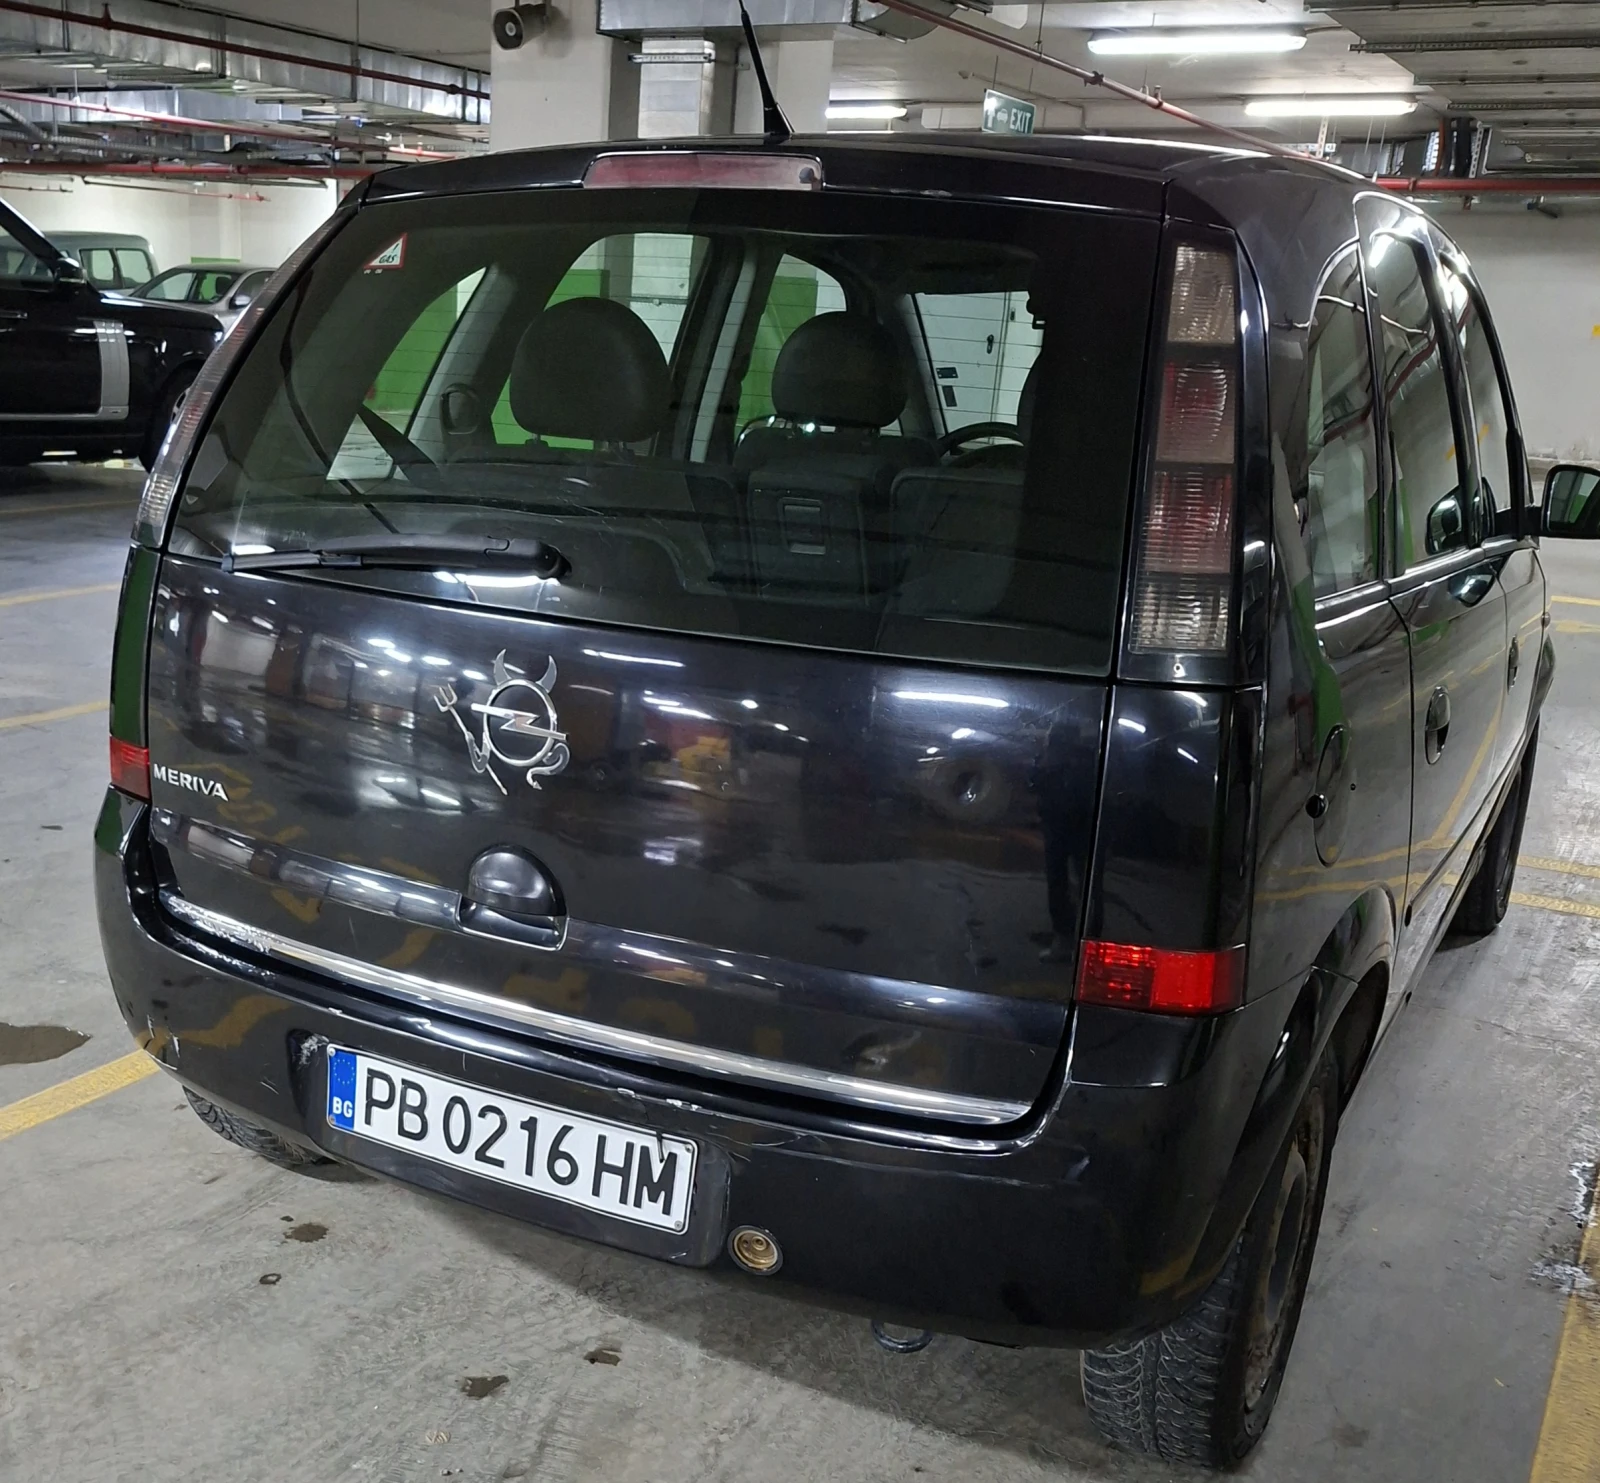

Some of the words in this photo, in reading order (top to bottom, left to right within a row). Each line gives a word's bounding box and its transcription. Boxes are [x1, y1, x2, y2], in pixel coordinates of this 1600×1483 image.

[1009, 107, 1032, 134] EXIT
[379, 254, 397, 264] GAS
[153, 763, 229, 802] MERIVA
[332, 1096, 353, 1118] BG
[364, 1067, 429, 1141] PB
[442, 1095, 579, 1186] 0216
[592, 1134, 678, 1216] HM
